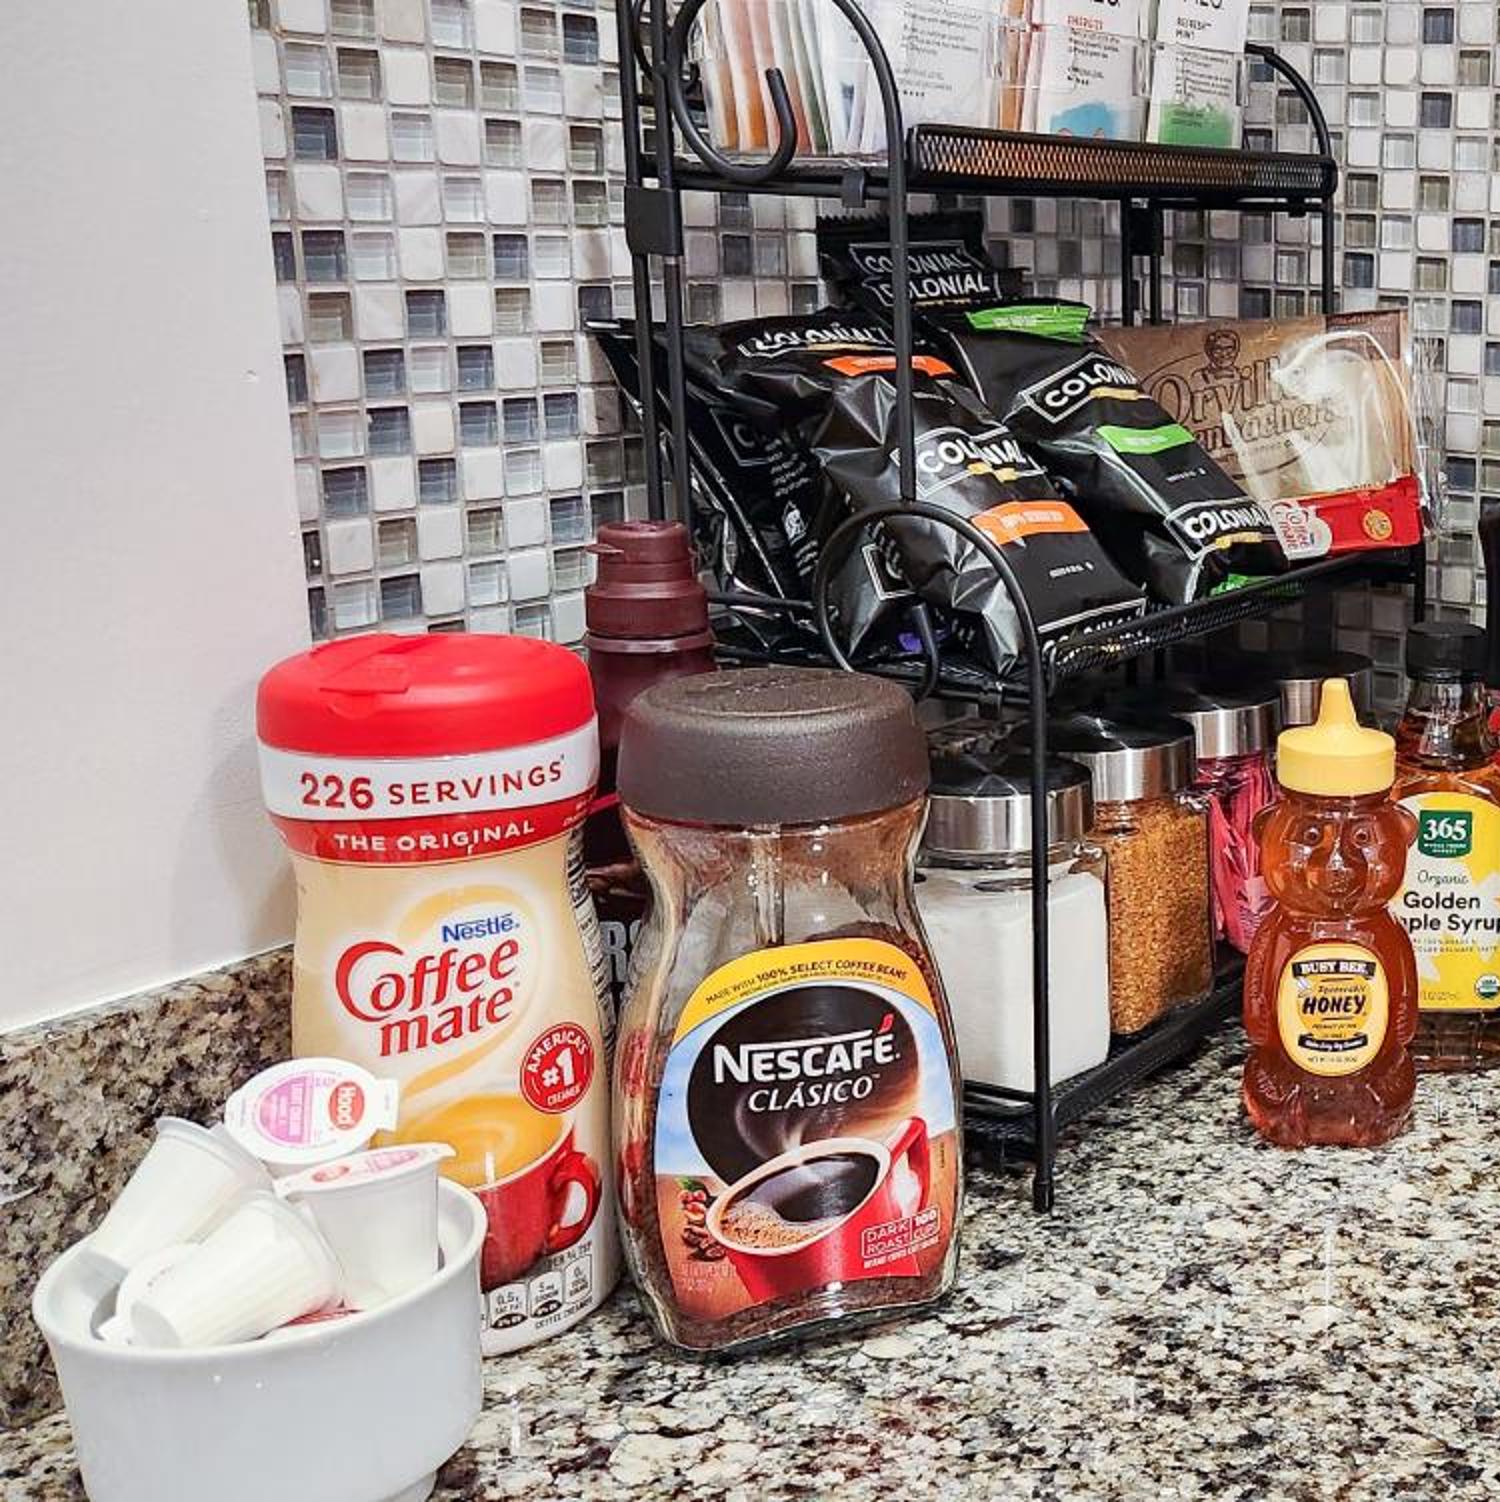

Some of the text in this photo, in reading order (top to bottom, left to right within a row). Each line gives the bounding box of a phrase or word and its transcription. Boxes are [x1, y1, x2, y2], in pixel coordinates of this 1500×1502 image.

[864, 252, 971, 279] COONIAL
[879, 275, 990, 298] CLONIAL
[300, 760, 562, 811] 226 SERVINGS
[333, 819, 535, 852] THE ORIGINAL
[1423, 818, 1468, 841] 365
[1417, 869, 1468, 888] Organic
[1403, 891, 1480, 910] Golden
[1400, 913, 1441, 934] ple
[335, 938, 520, 1023] Coffee
[790, 960, 832, 976] SELECT
[835, 959, 875, 973] COFFEE
[1301, 962, 1338, 974] BUSY
[1302, 995, 1367, 1015] HONEY
[379, 986, 514, 1058] mate
[713, 1015, 896, 1084] NESCAFÉ
[541, 1047, 576, 1088] #1
[336, 1087, 357, 1125] Hood
[748, 1075, 873, 1113] CLÁSICO
[866, 1219, 909, 1243] DARK
[866, 1230, 909, 1257] ROAST
